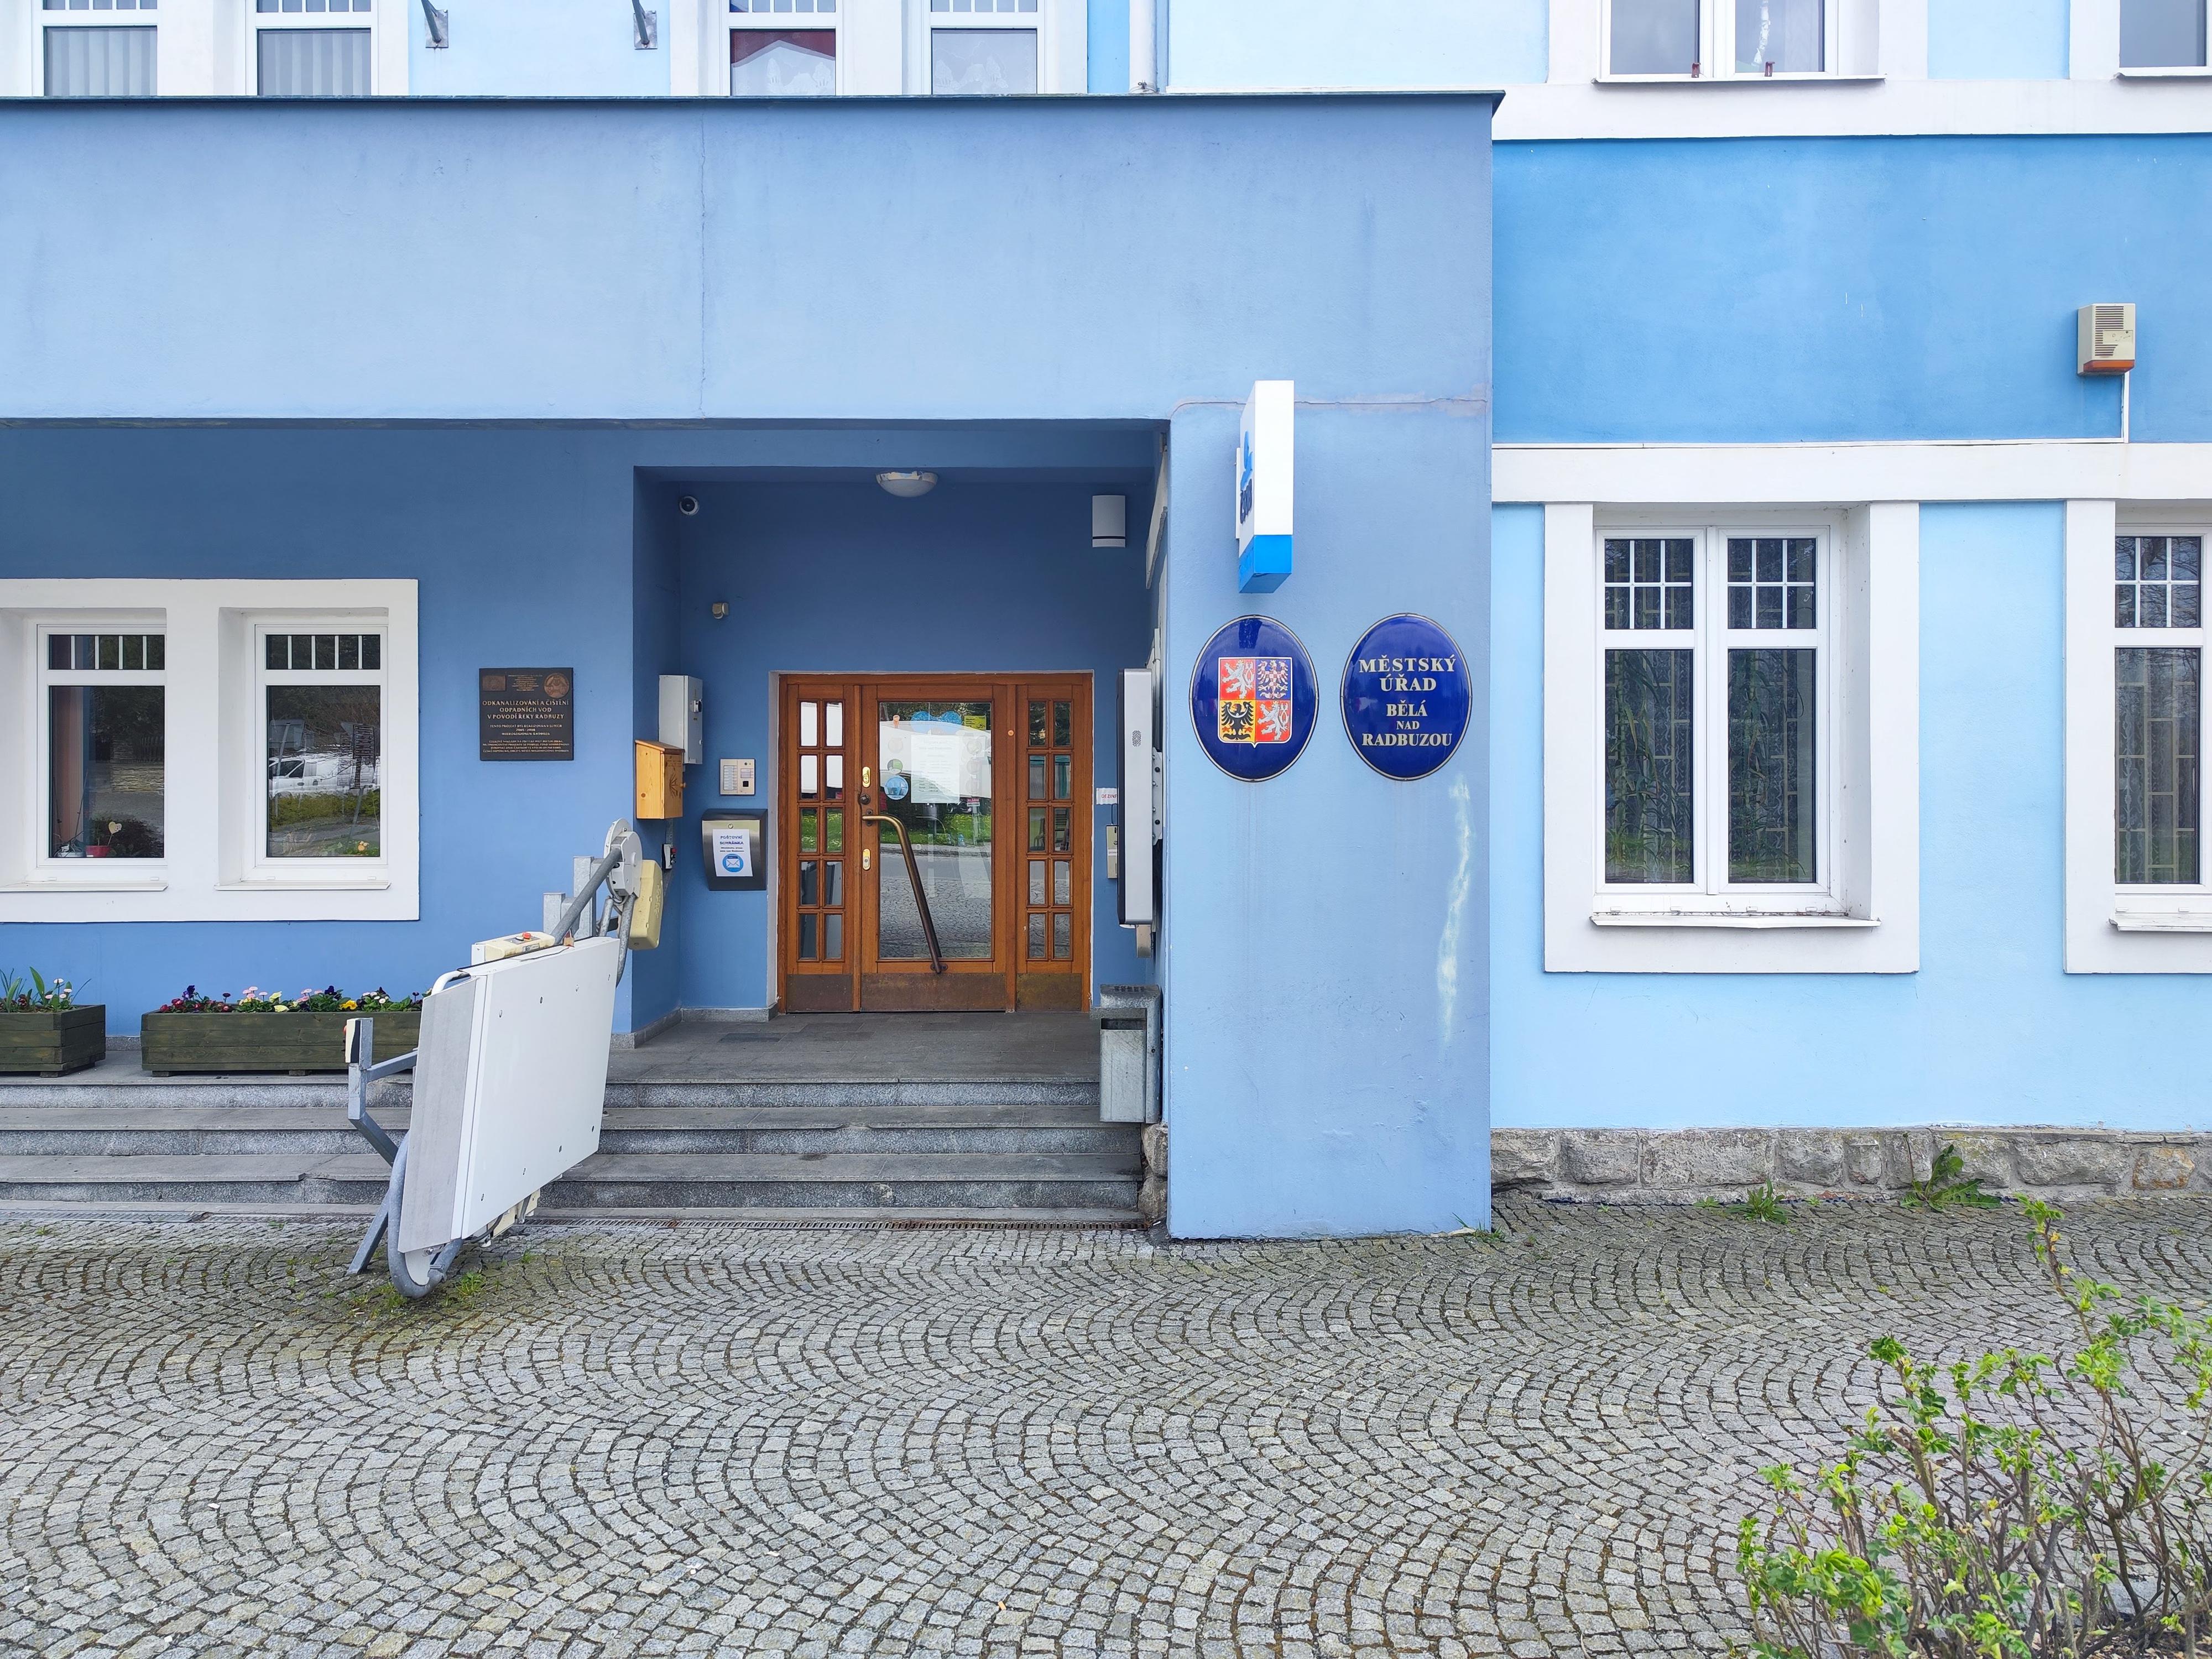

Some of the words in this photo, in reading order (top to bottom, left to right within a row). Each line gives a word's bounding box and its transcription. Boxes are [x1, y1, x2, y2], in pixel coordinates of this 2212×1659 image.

[1359, 654, 1457, 674] MĚSTSKÝ
[1379, 674, 1437, 692] ÚŘAD
[1386, 700, 1427, 717] BĚLÁ
[1396, 721, 1420, 730] NAD
[1362, 733, 1453, 747] RADBUZOU
